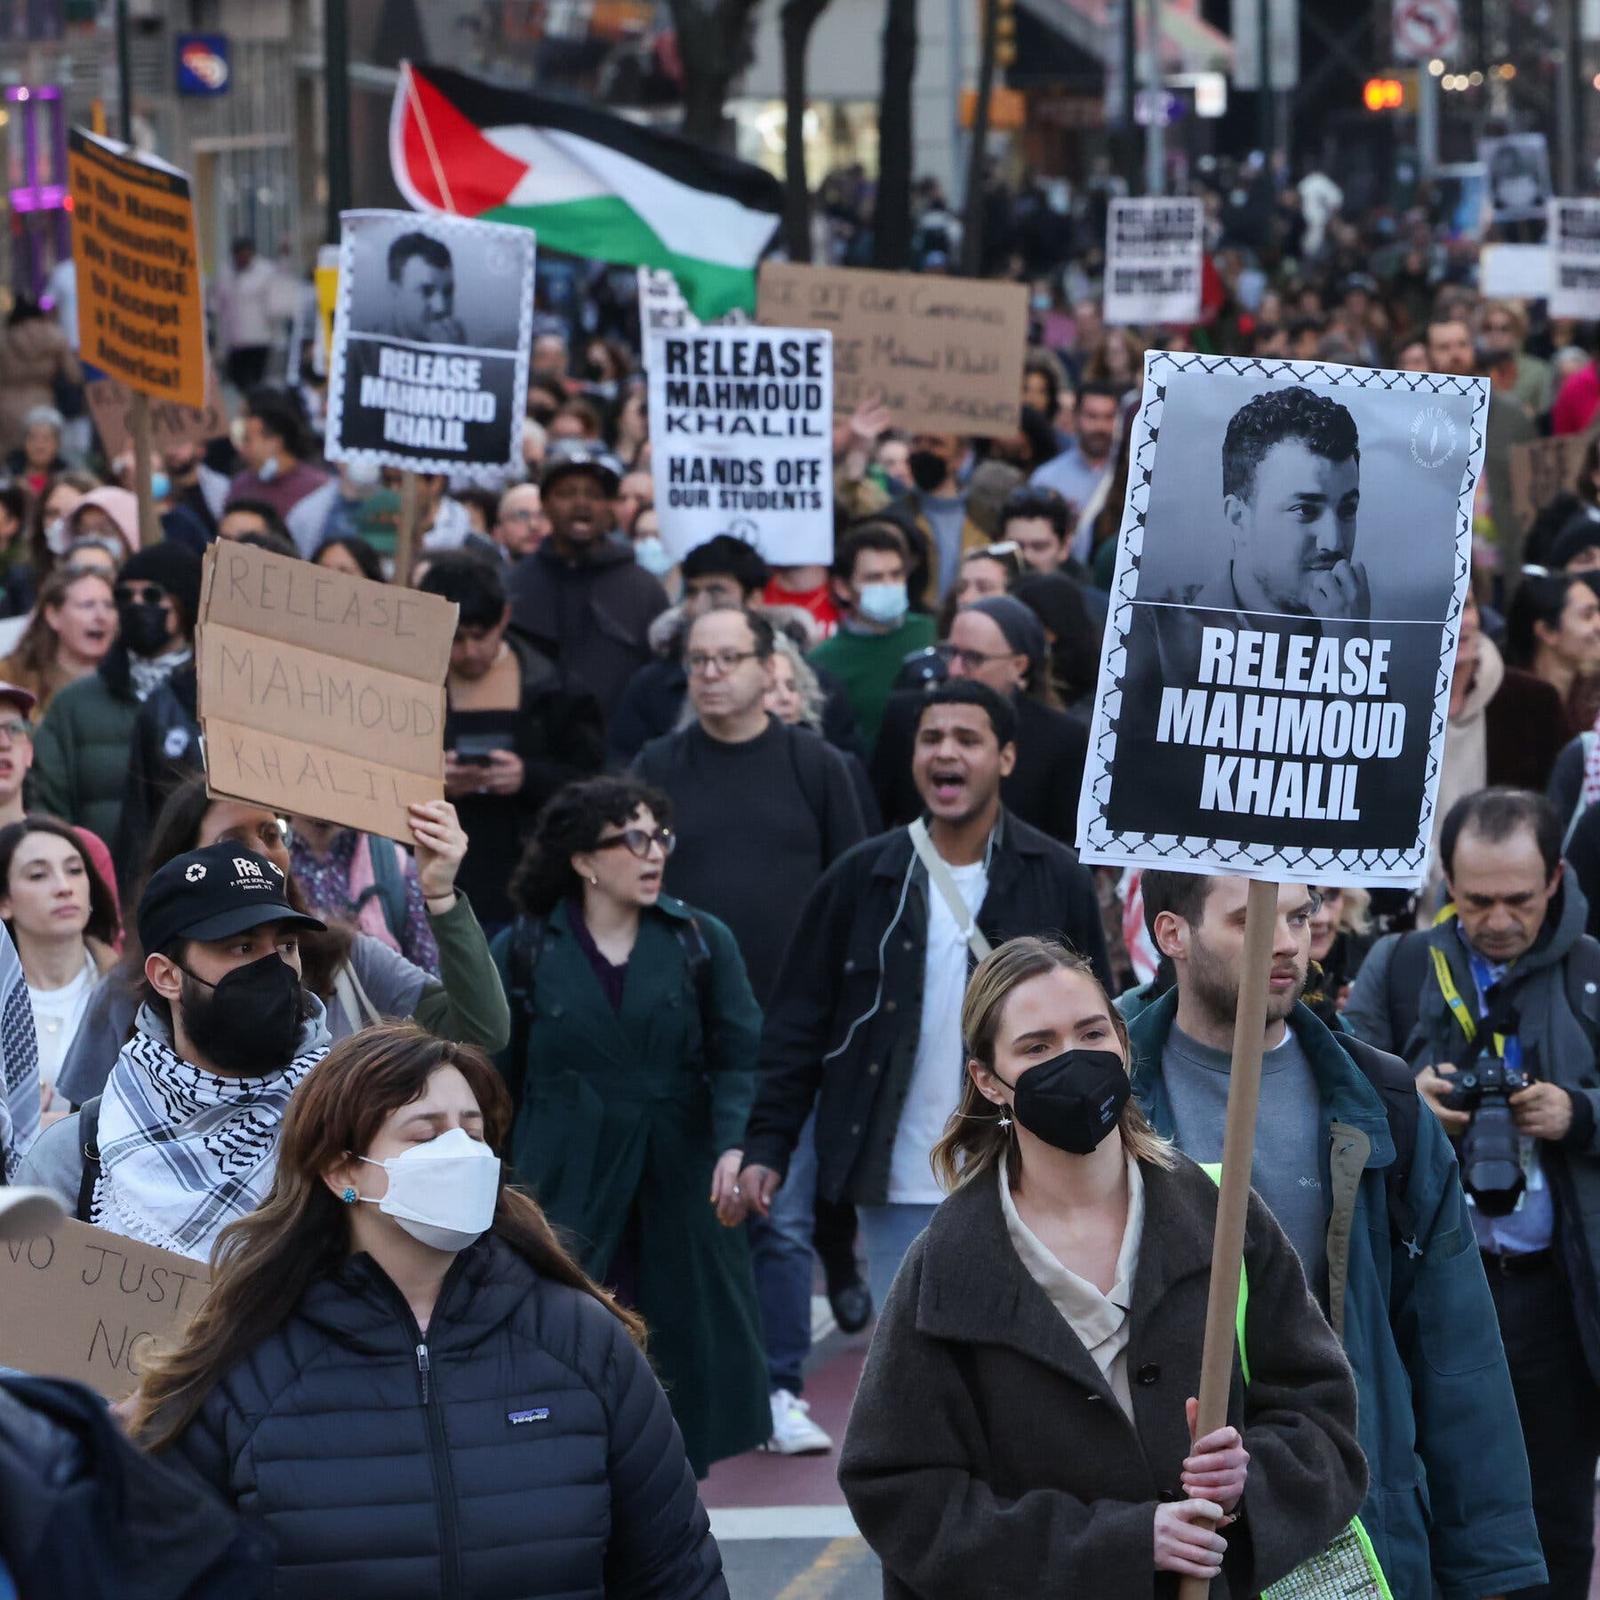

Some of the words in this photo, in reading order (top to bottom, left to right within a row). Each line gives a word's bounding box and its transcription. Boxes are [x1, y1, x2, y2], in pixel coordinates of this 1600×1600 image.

[124, 190, 188, 232] Name
[109, 249, 189, 297] REFUSE
[109, 282, 180, 327] Accept
[108, 310, 180, 358] Fascist
[96, 335, 181, 389] America!
[379, 347, 482, 391] RELEASE
[665, 339, 823, 378] RELEASE
[360, 375, 497, 423] MAHMOUD
[665, 380, 823, 412] MAHMOUD
[384, 408, 468, 452] KHALIL
[666, 413, 824, 438] KHALIL
[669, 456, 765, 487] HANDS
[775, 458, 822, 487] OFF
[668, 488, 711, 509] OUR
[718, 489, 823, 512] STUDENTS
[229, 556, 420, 638] RELEASE
[1198, 626, 1392, 696] RELEASE
[219, 644, 436, 738] MAHMOUD
[1156, 686, 1407, 760] MAHMOUD
[230, 737, 413, 809] KHALIL
[1199, 753, 1360, 821] KHALIL
